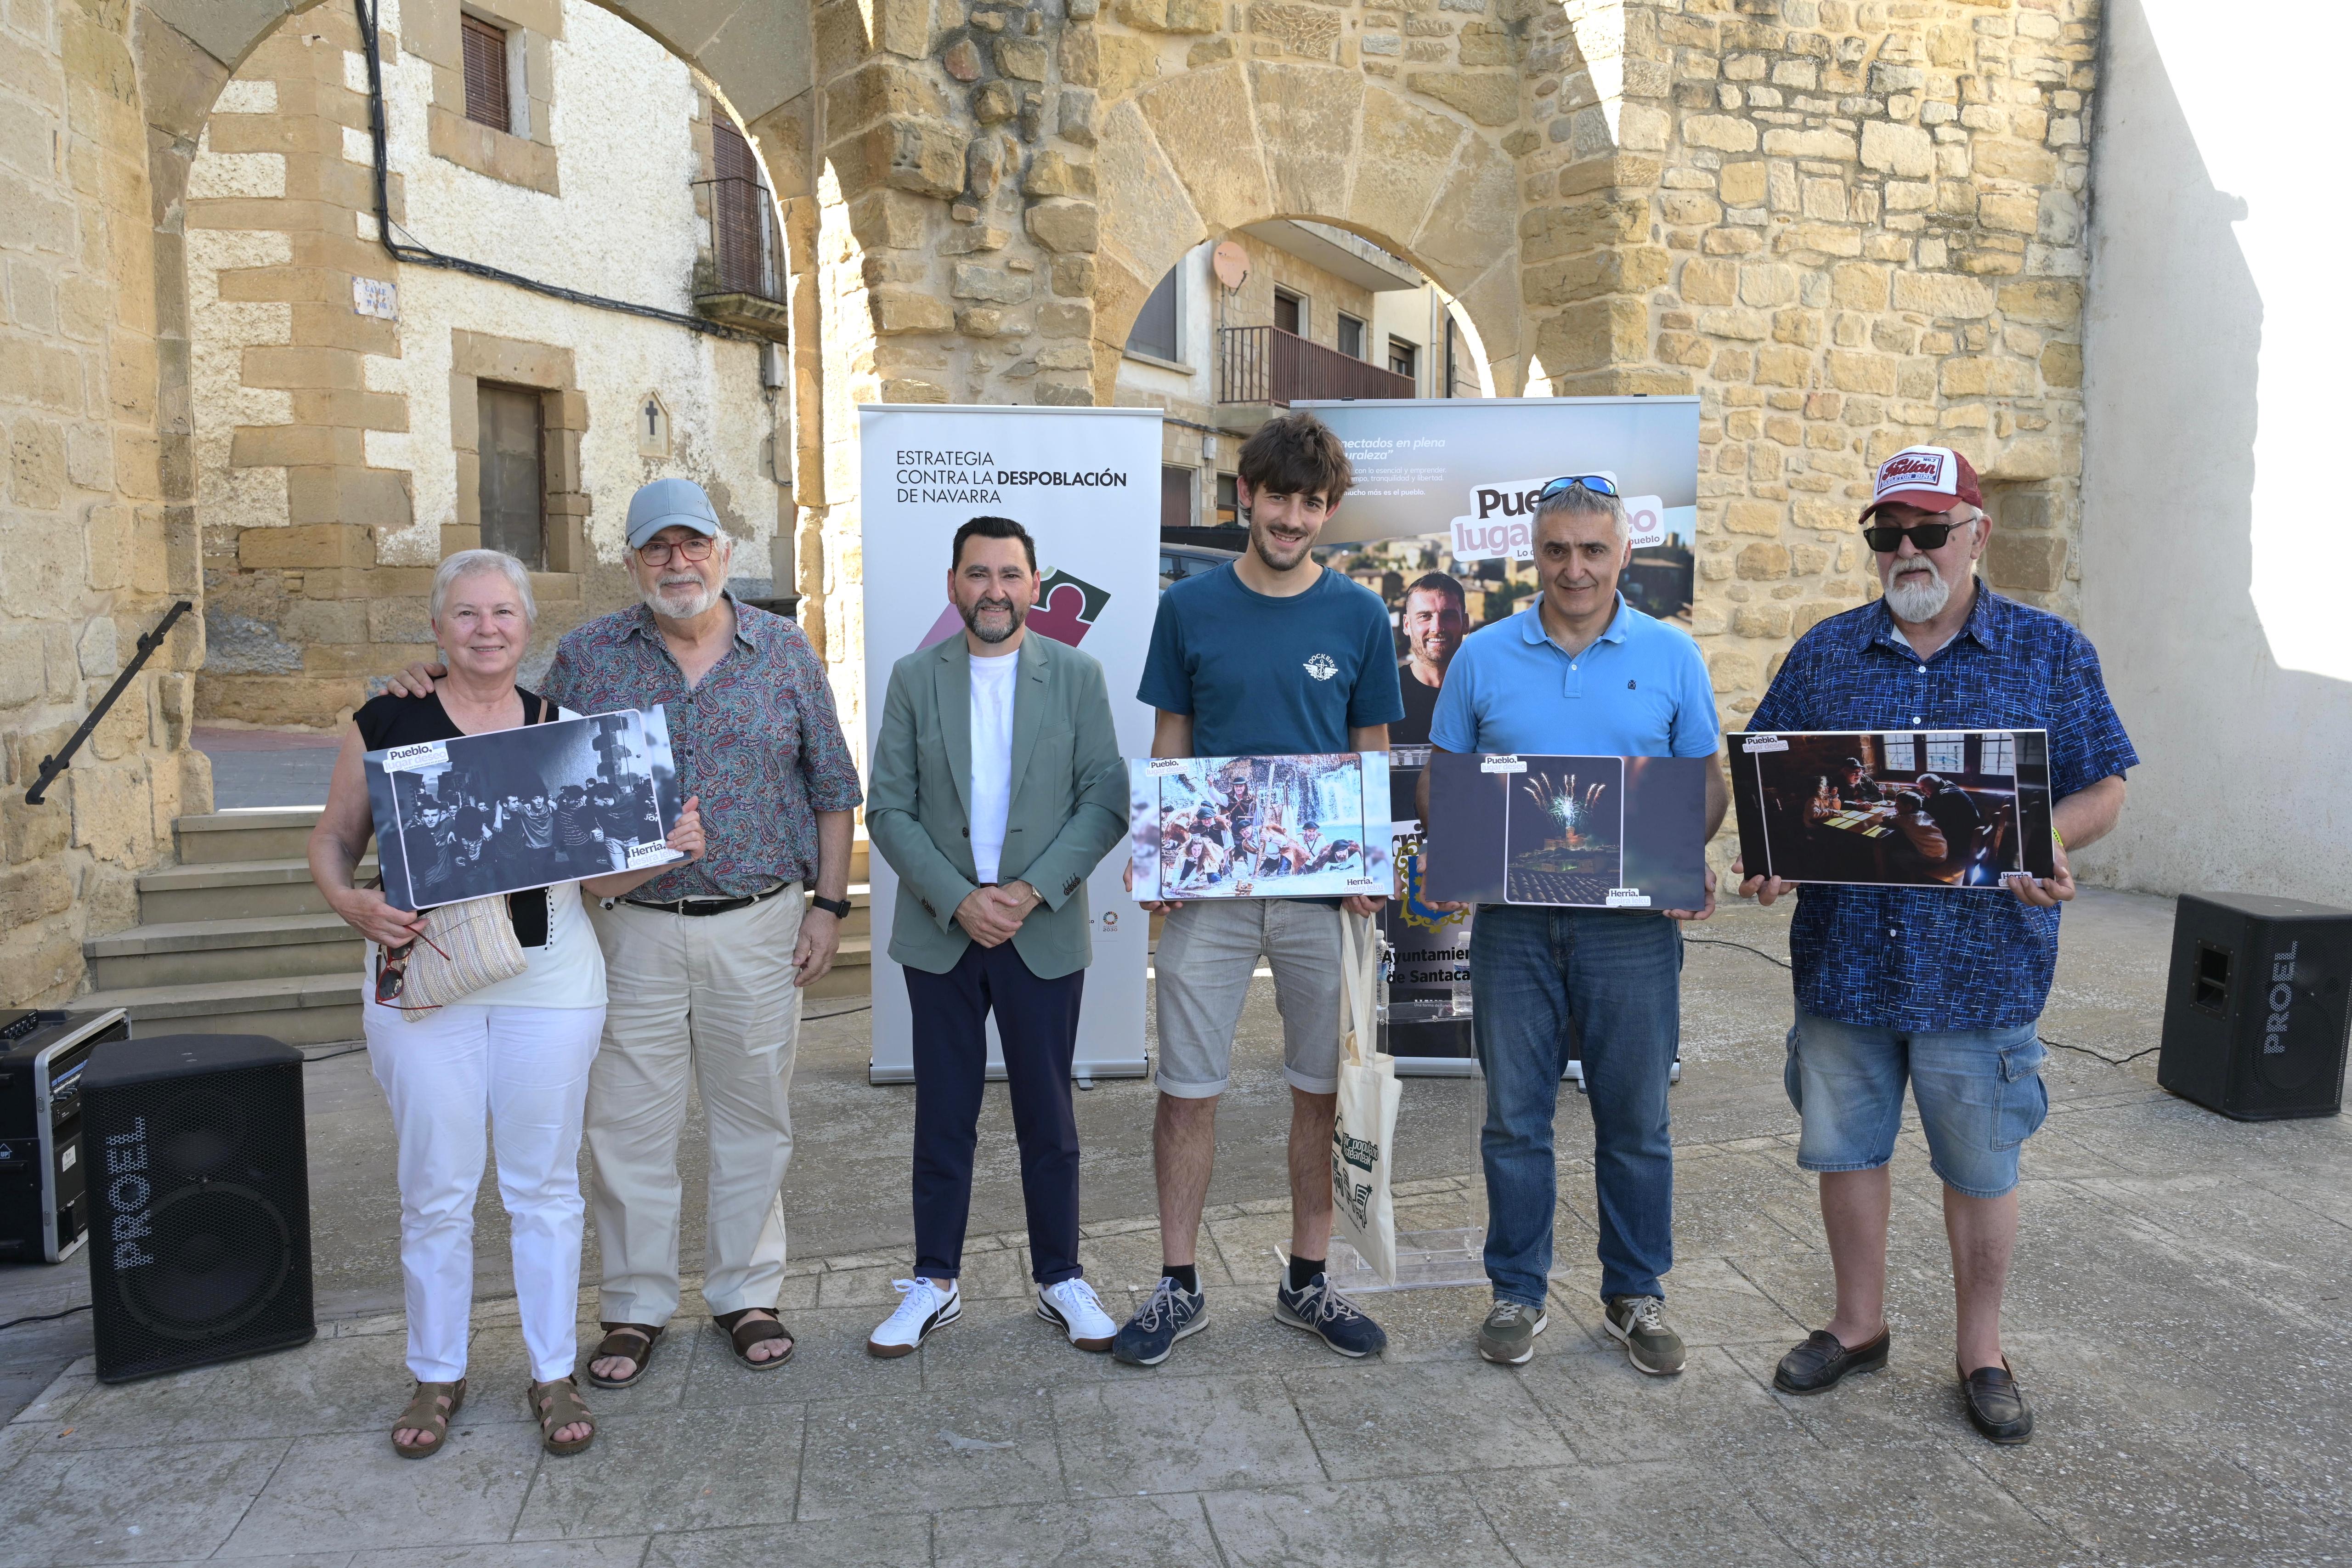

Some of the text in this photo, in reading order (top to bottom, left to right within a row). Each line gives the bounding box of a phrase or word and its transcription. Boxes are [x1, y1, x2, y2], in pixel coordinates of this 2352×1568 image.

[365, 286, 386, 295] CALLE
[368, 300, 387, 310] MOR
[1341, 437, 1393, 448] nectados
[1413, 437, 1446, 450] plena
[897, 450, 994, 466] ESTRATEGIA
[897, 468, 1127, 487] CONTRA LA DESPOBLACIÓN
[1410, 466, 1447, 475] emprender.
[1371, 475, 1409, 483] tranquilidad
[897, 488, 1002, 504] DE NAVARRA
[1476, 488, 1543, 519] Pue
[1454, 523, 1532, 556] luga
[1308, 653, 1335, 668] DOCKERS
[1747, 736, 1777, 745] Pueblo,
[390, 745, 432, 760] Pueblo,
[385, 751, 447, 771] lugar deseo
[1151, 760, 1179, 768] Pueblo,
[631, 842, 666, 857] Herria,
[629, 853, 658, 867] desira
[1347, 877, 1373, 885] Herria,
[1611, 889, 1638, 897] Herria,
[1386, 969, 1470, 984] de Santaca
[2264, 940, 2297, 1053] PROEL
[106, 1116, 154, 1270] PROEL
